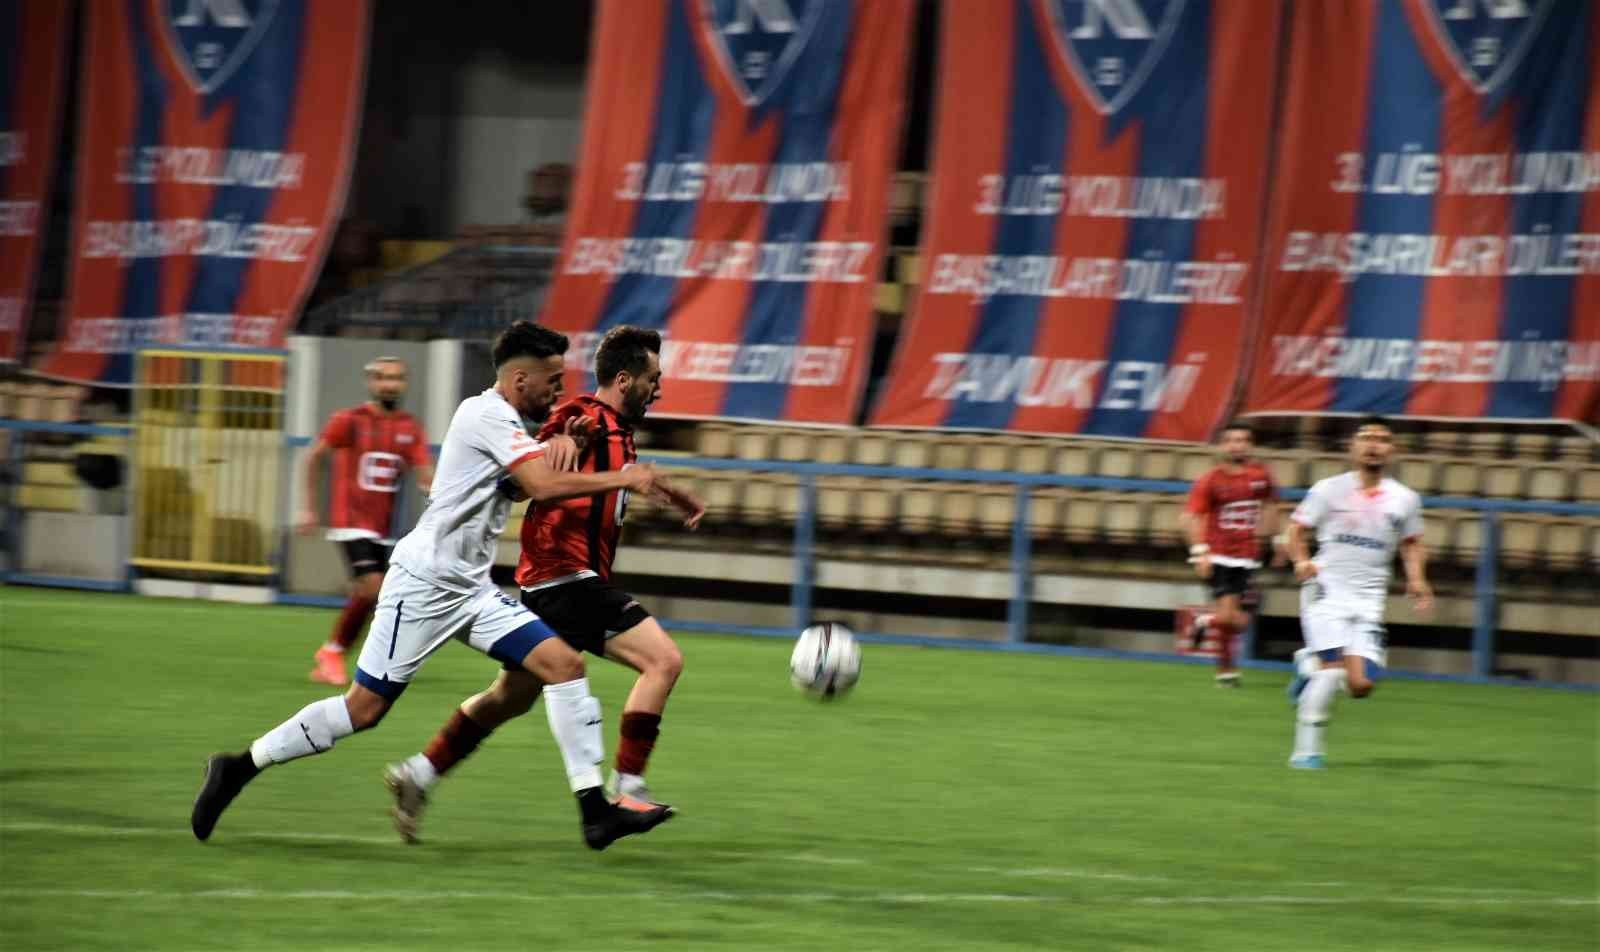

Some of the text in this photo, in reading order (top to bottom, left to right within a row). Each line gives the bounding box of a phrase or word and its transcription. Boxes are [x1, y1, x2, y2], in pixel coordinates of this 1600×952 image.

[1066, 174, 1228, 220] YOLUNDA
[562, 232, 874, 284] BAŞARILAR DİLERİZ
[926, 249, 1249, 305] BAŞARILAR DİLERİZ
[1280, 231, 1504, 283] BAŞARILAR
[922, 351, 1209, 412] TAVUK EVİ
